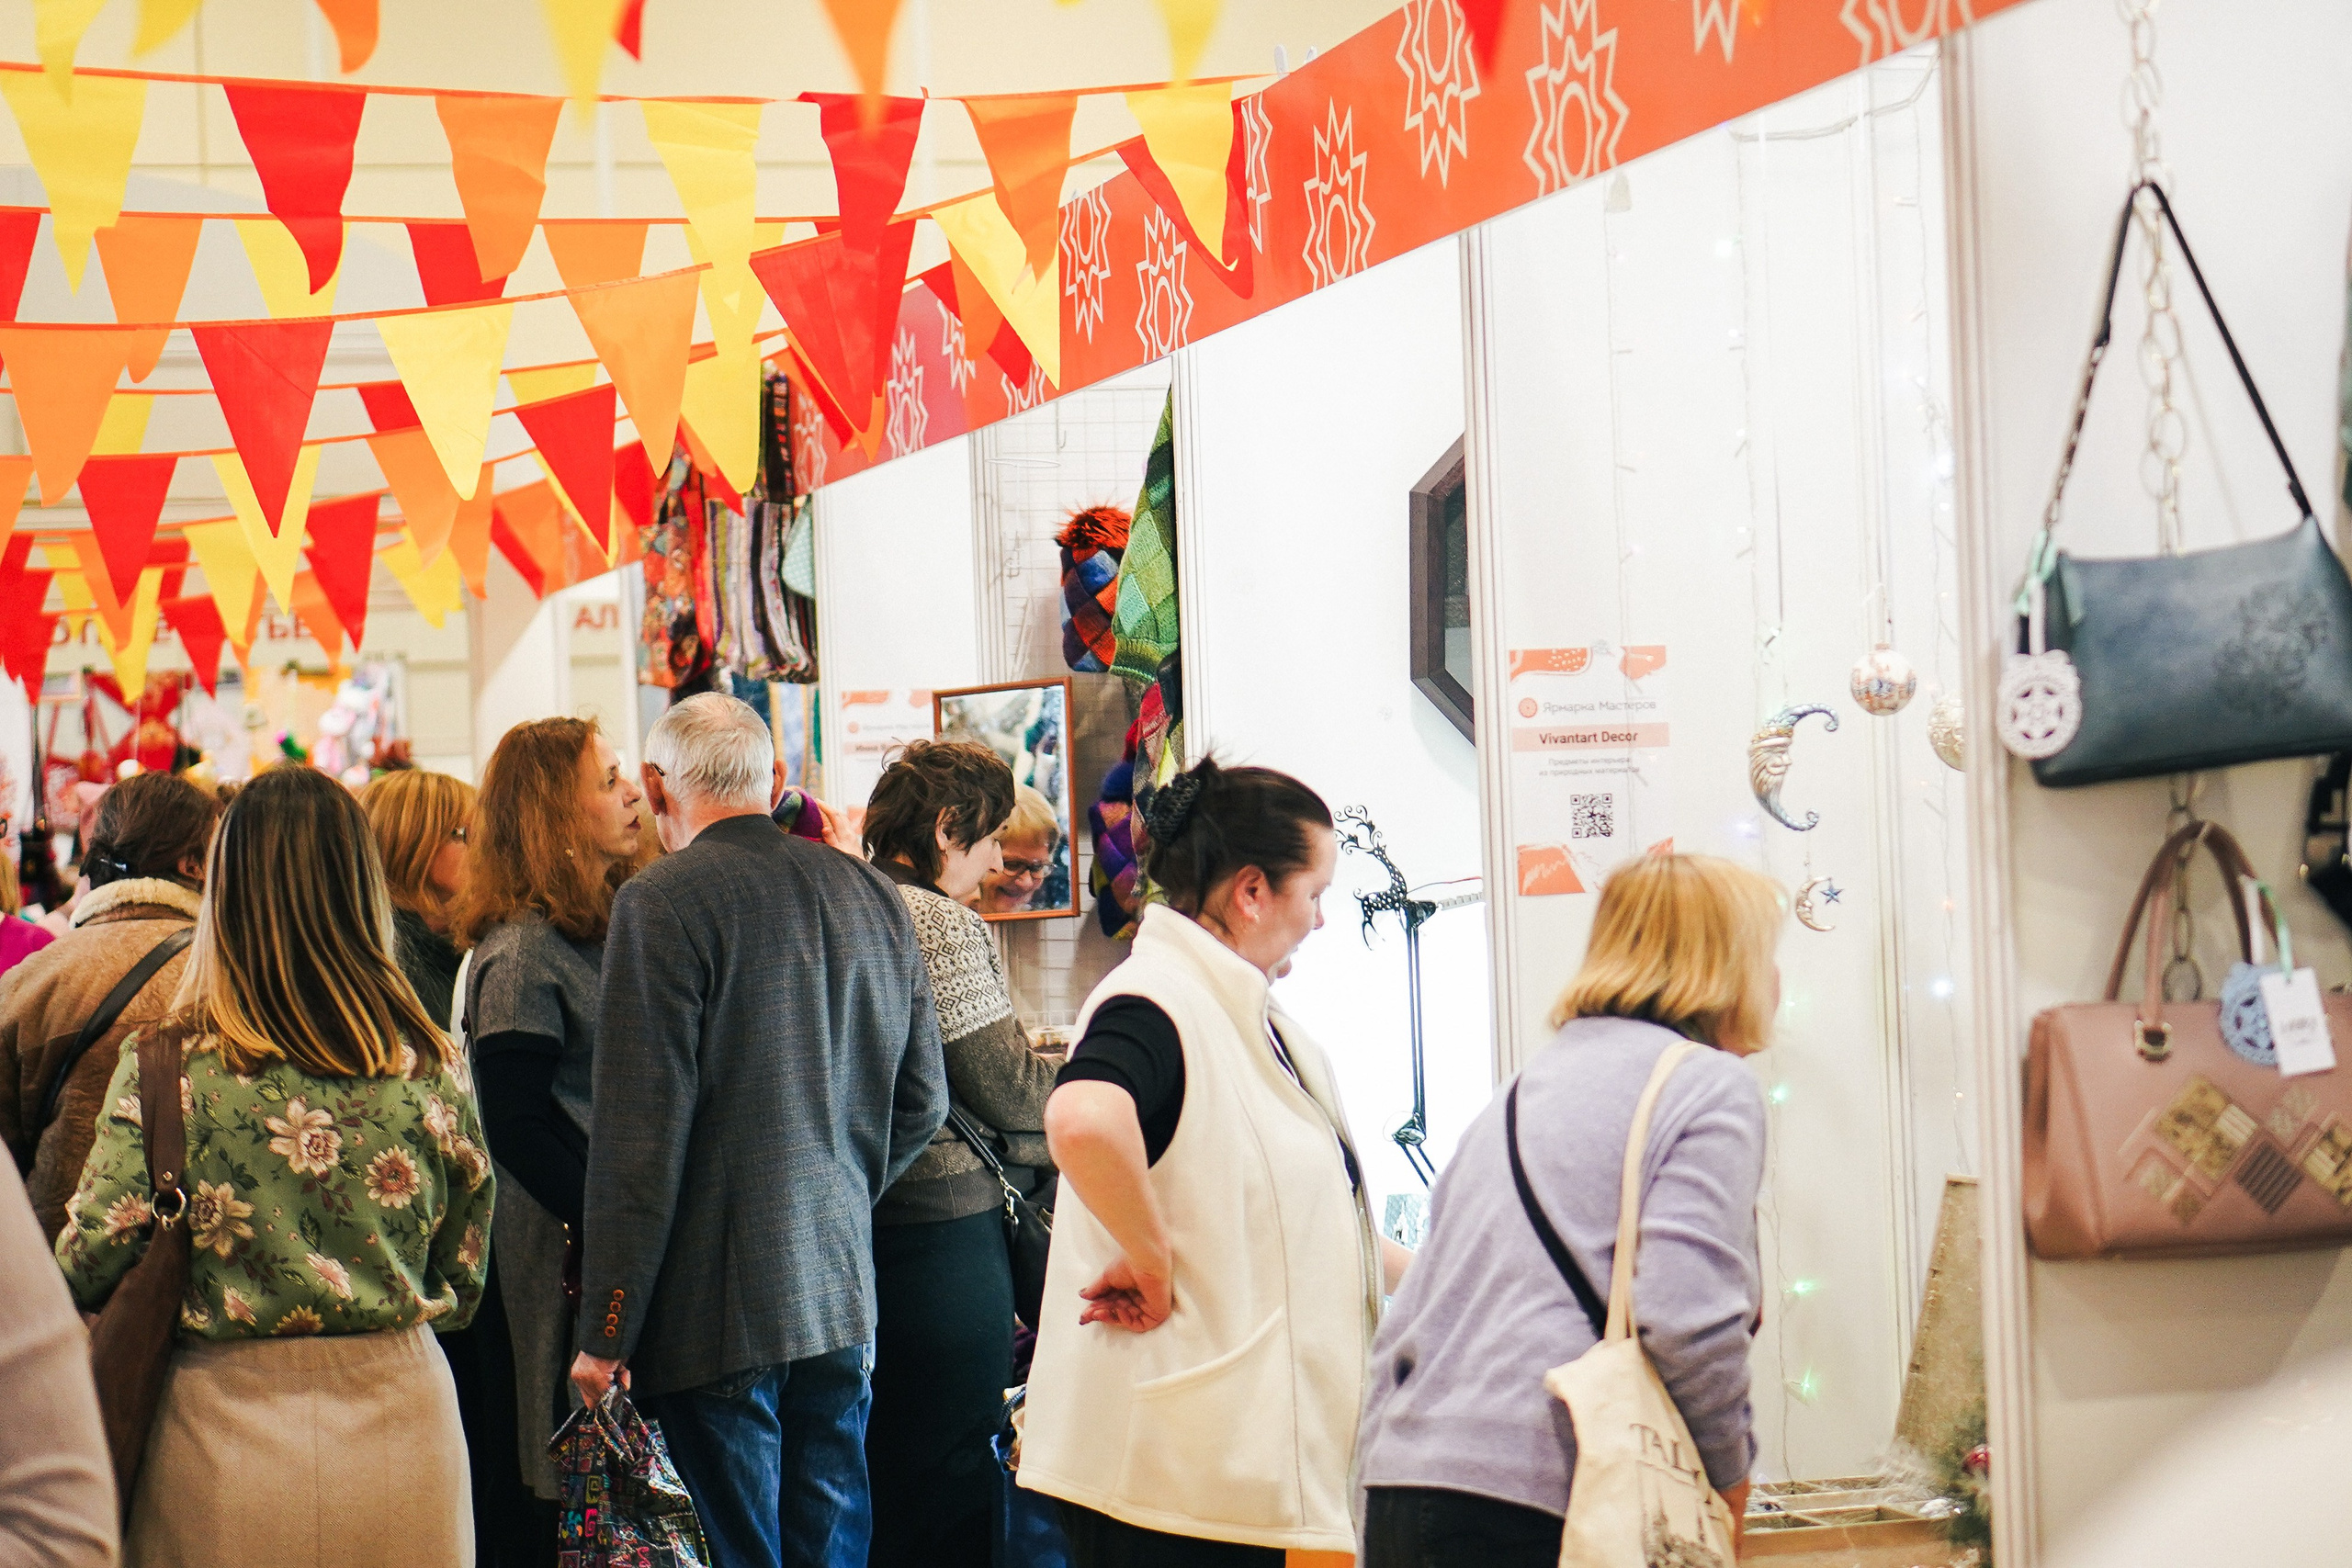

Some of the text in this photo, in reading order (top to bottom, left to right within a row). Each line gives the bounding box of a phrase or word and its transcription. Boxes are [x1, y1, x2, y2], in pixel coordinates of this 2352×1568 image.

[1543, 701, 1657, 715] Ярмарка Мастеров
[1539, 730, 1639, 744] Vivantart Decor
